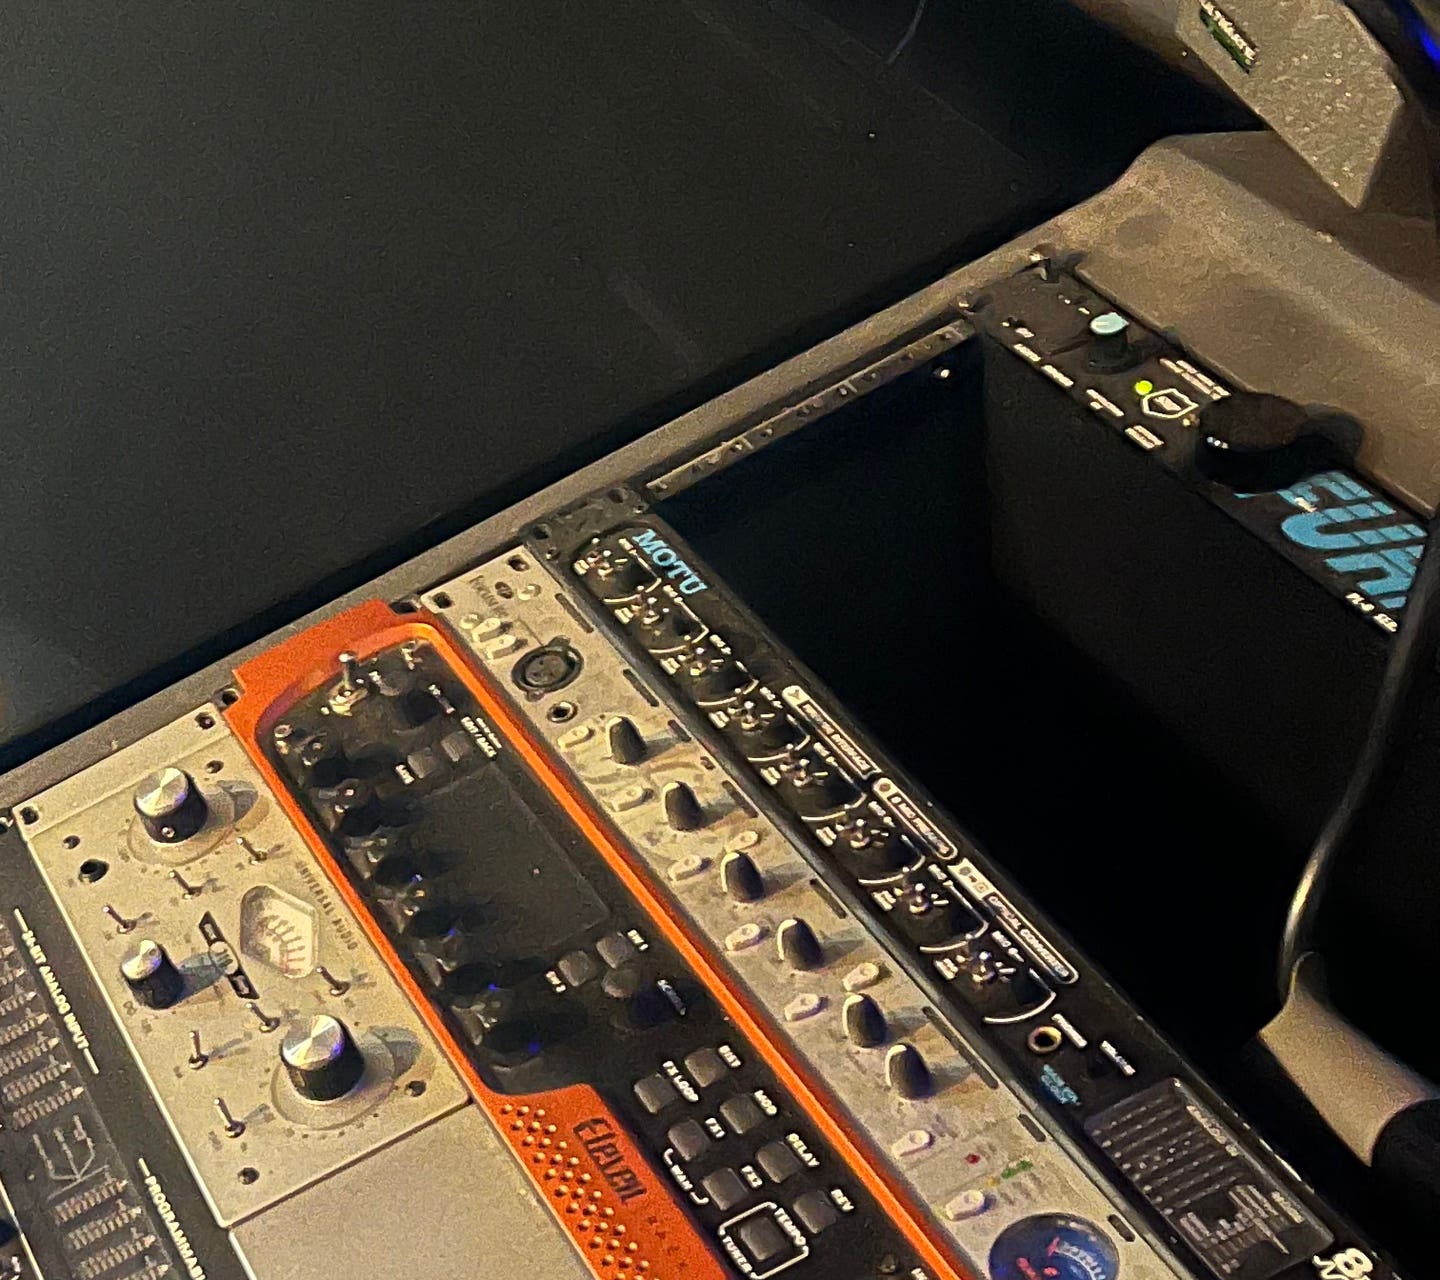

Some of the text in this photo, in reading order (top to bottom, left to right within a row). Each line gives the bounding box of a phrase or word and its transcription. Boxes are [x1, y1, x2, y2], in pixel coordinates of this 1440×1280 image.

[632, 528, 708, 596] MOTU
[37, 963, 72, 1015] ANALOG
[62, 1012, 90, 1051] INPUT
